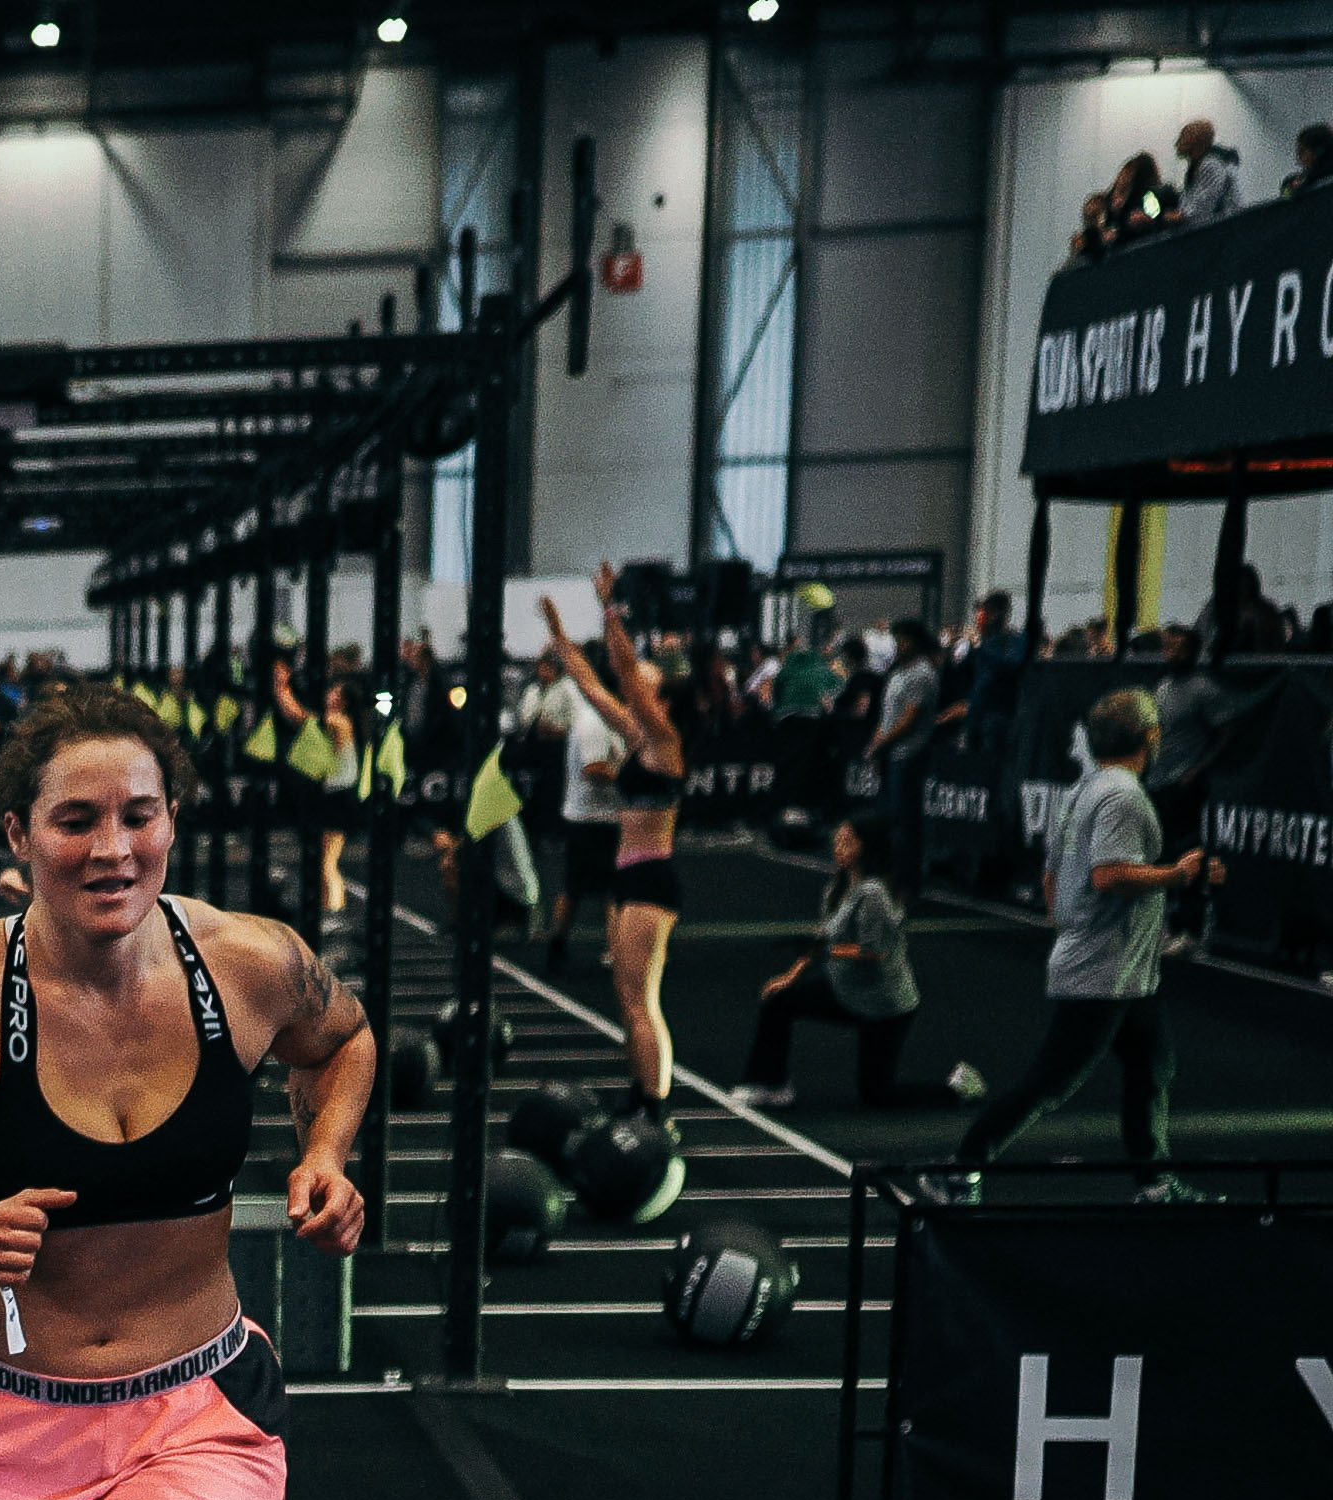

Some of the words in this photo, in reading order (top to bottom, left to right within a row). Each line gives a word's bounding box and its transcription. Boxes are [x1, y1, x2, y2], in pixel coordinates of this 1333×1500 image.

[1137, 303, 1165, 397] IS
[1216, 803, 1333, 866] MYPROTE
[8, 975, 29, 1062] PRO
[47, 1380, 127, 1404] UNDER
[129, 1343, 220, 1399] ARMOUR
